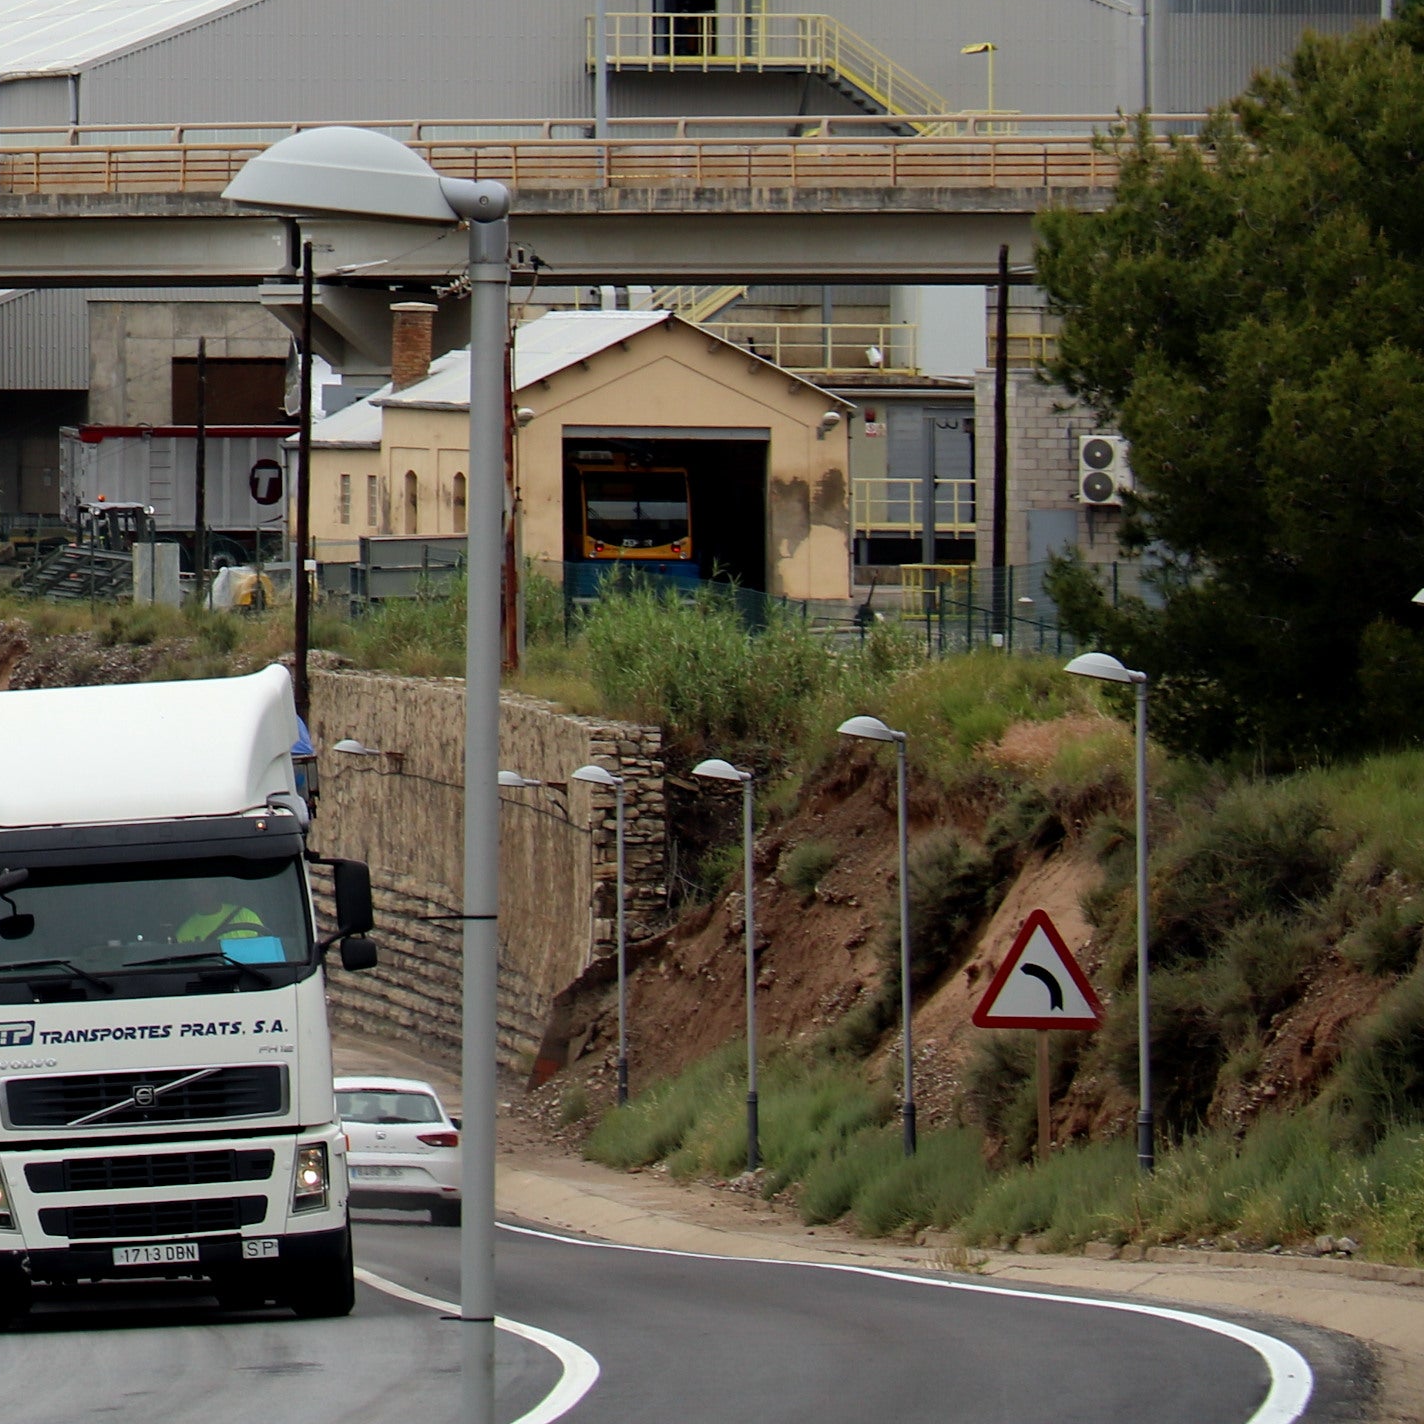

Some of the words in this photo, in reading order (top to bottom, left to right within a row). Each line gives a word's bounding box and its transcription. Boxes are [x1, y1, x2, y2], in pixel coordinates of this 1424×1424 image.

[254, 468, 279, 498] T
[39, 1025, 172, 1044] TRANSPORTES
[253, 1019, 288, 1034] S.A.
[124, 1247, 161, 1263] 1713
[166, 1245, 195, 1261] DBN
